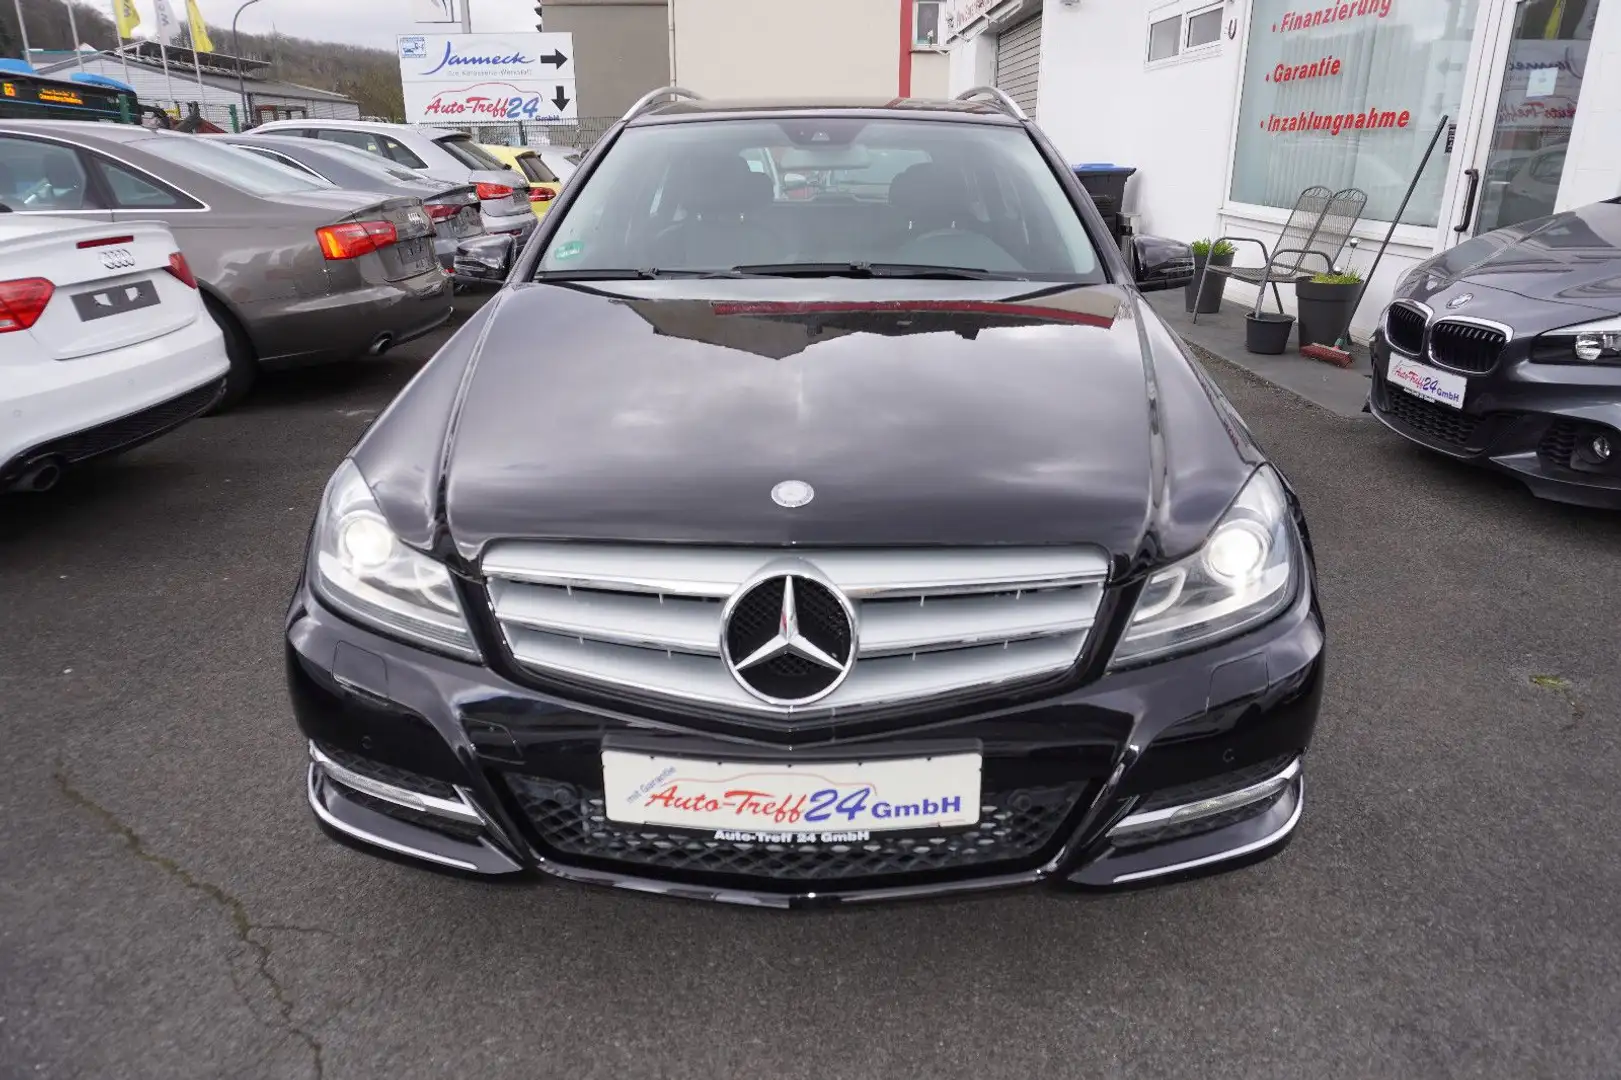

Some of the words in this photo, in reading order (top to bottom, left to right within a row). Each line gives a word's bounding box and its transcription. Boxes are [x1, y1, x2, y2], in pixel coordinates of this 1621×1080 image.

[1280, 0, 1392, 33] Finanzierung
[1273, 55, 1341, 83] Garantie
[1267, 107, 1410, 135] Inzahlungnahme
[1436, 388, 1460, 402] GmbH
[871, 796, 961, 819] GmbH
[713, 829, 792, 843] Auto-Treff
[796, 831, 817, 843] 24
[820, 830, 870, 842] GmbH
